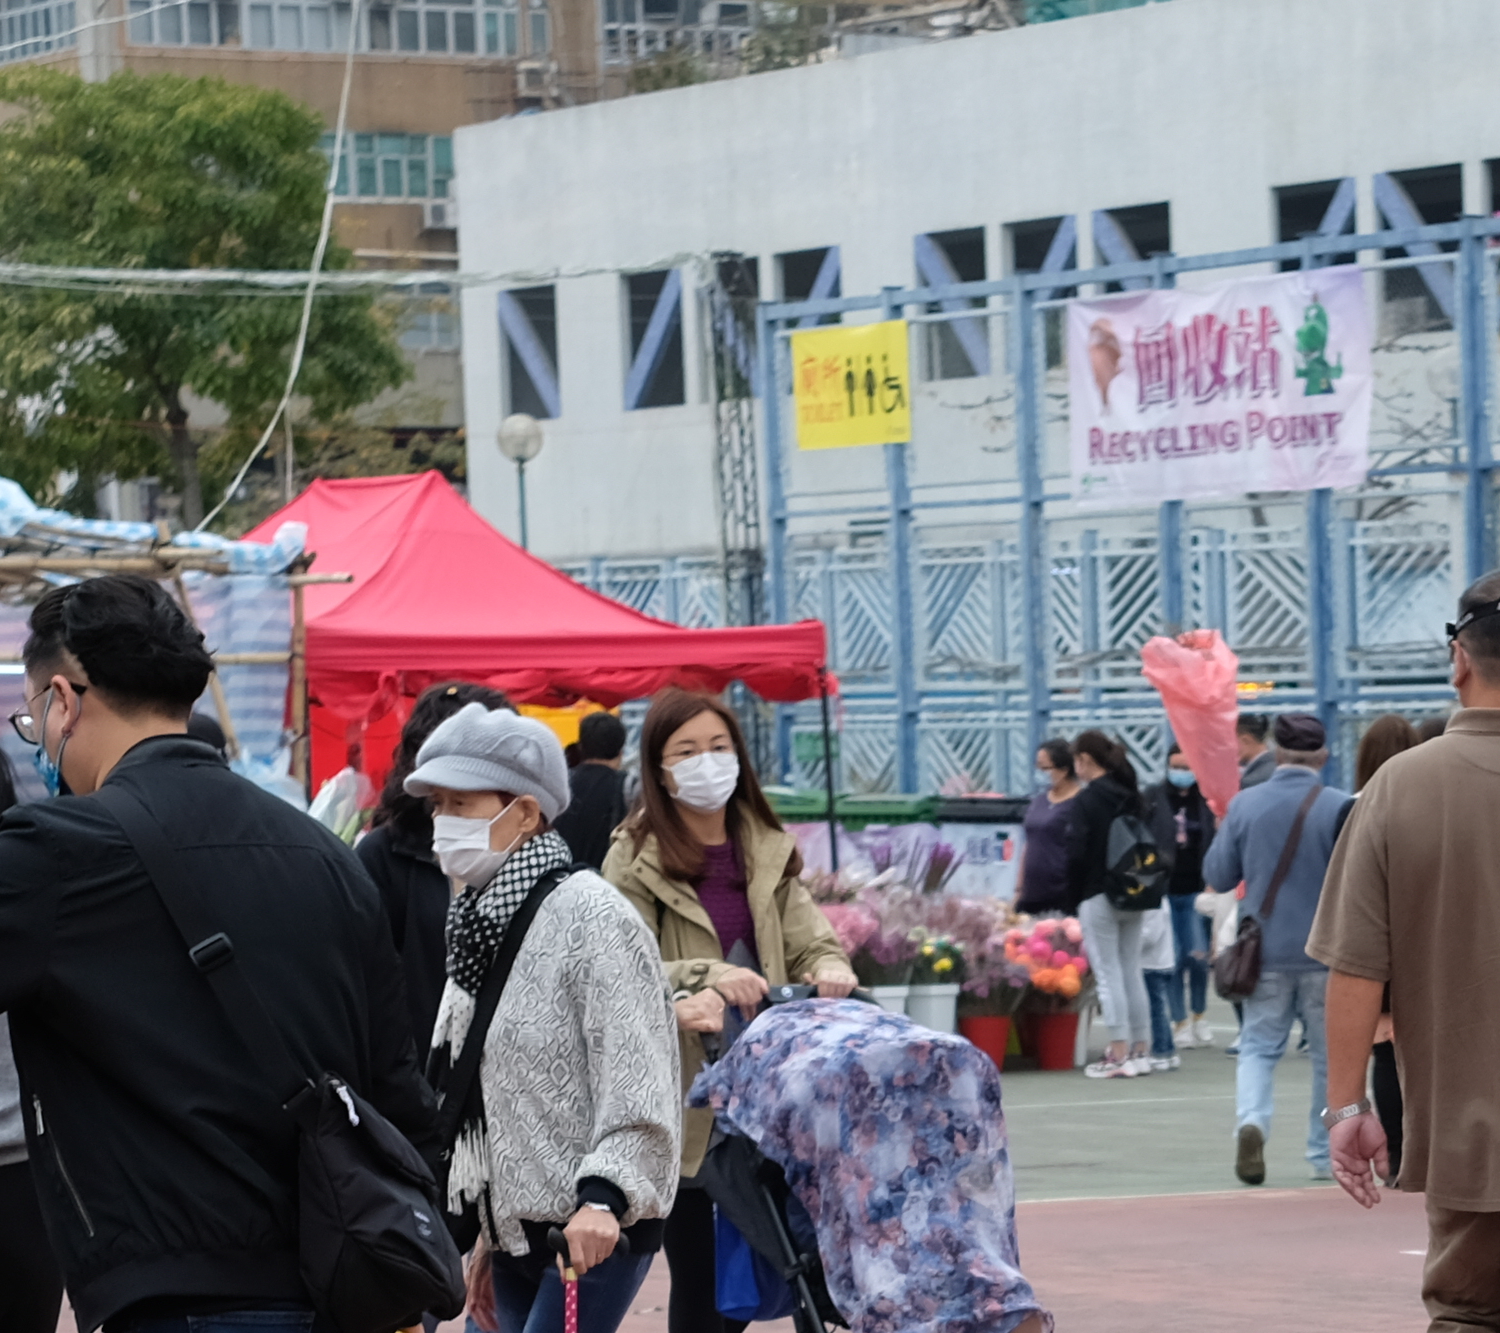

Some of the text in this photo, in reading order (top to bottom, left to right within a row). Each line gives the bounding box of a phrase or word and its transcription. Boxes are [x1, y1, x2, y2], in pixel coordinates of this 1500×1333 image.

[1133, 306, 1279, 410] 回收站
[1088, 411, 1342, 465] RECYCLING POINT
